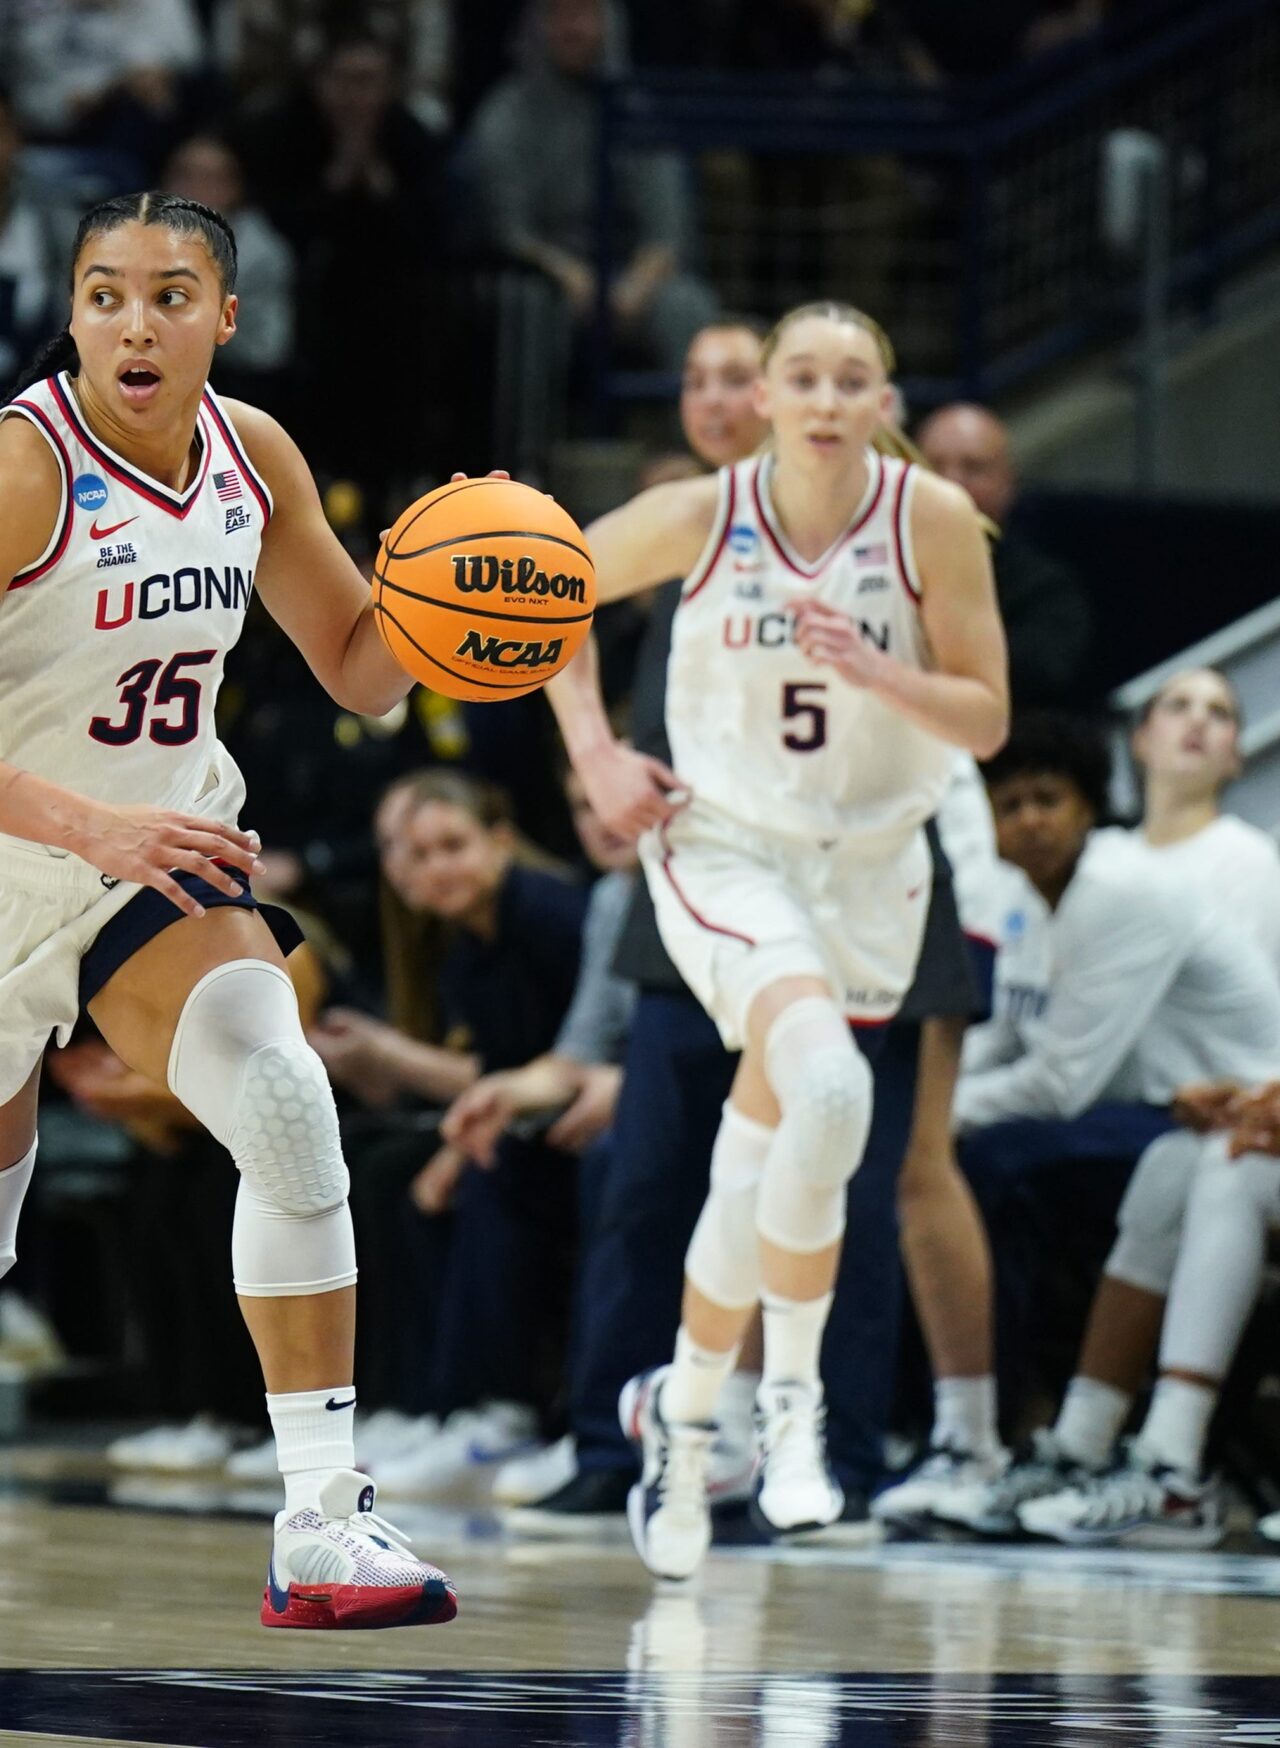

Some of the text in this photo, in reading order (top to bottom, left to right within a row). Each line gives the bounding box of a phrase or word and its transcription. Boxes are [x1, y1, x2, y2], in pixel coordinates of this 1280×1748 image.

[78, 489, 107, 503] NCAA
[225, 506, 244, 519] BIG
[225, 514, 252, 530] EAST
[96, 552, 137, 568] CHANGE
[99, 542, 134, 558] BE THE
[451, 555, 586, 604] Wilson
[95, 566, 252, 630] UCONN
[528, 597, 549, 606] NXT
[723, 611, 889, 654] UCN
[455, 628, 565, 668] NCAA
[88, 649, 218, 747] 35
[782, 682, 827, 752] 5
